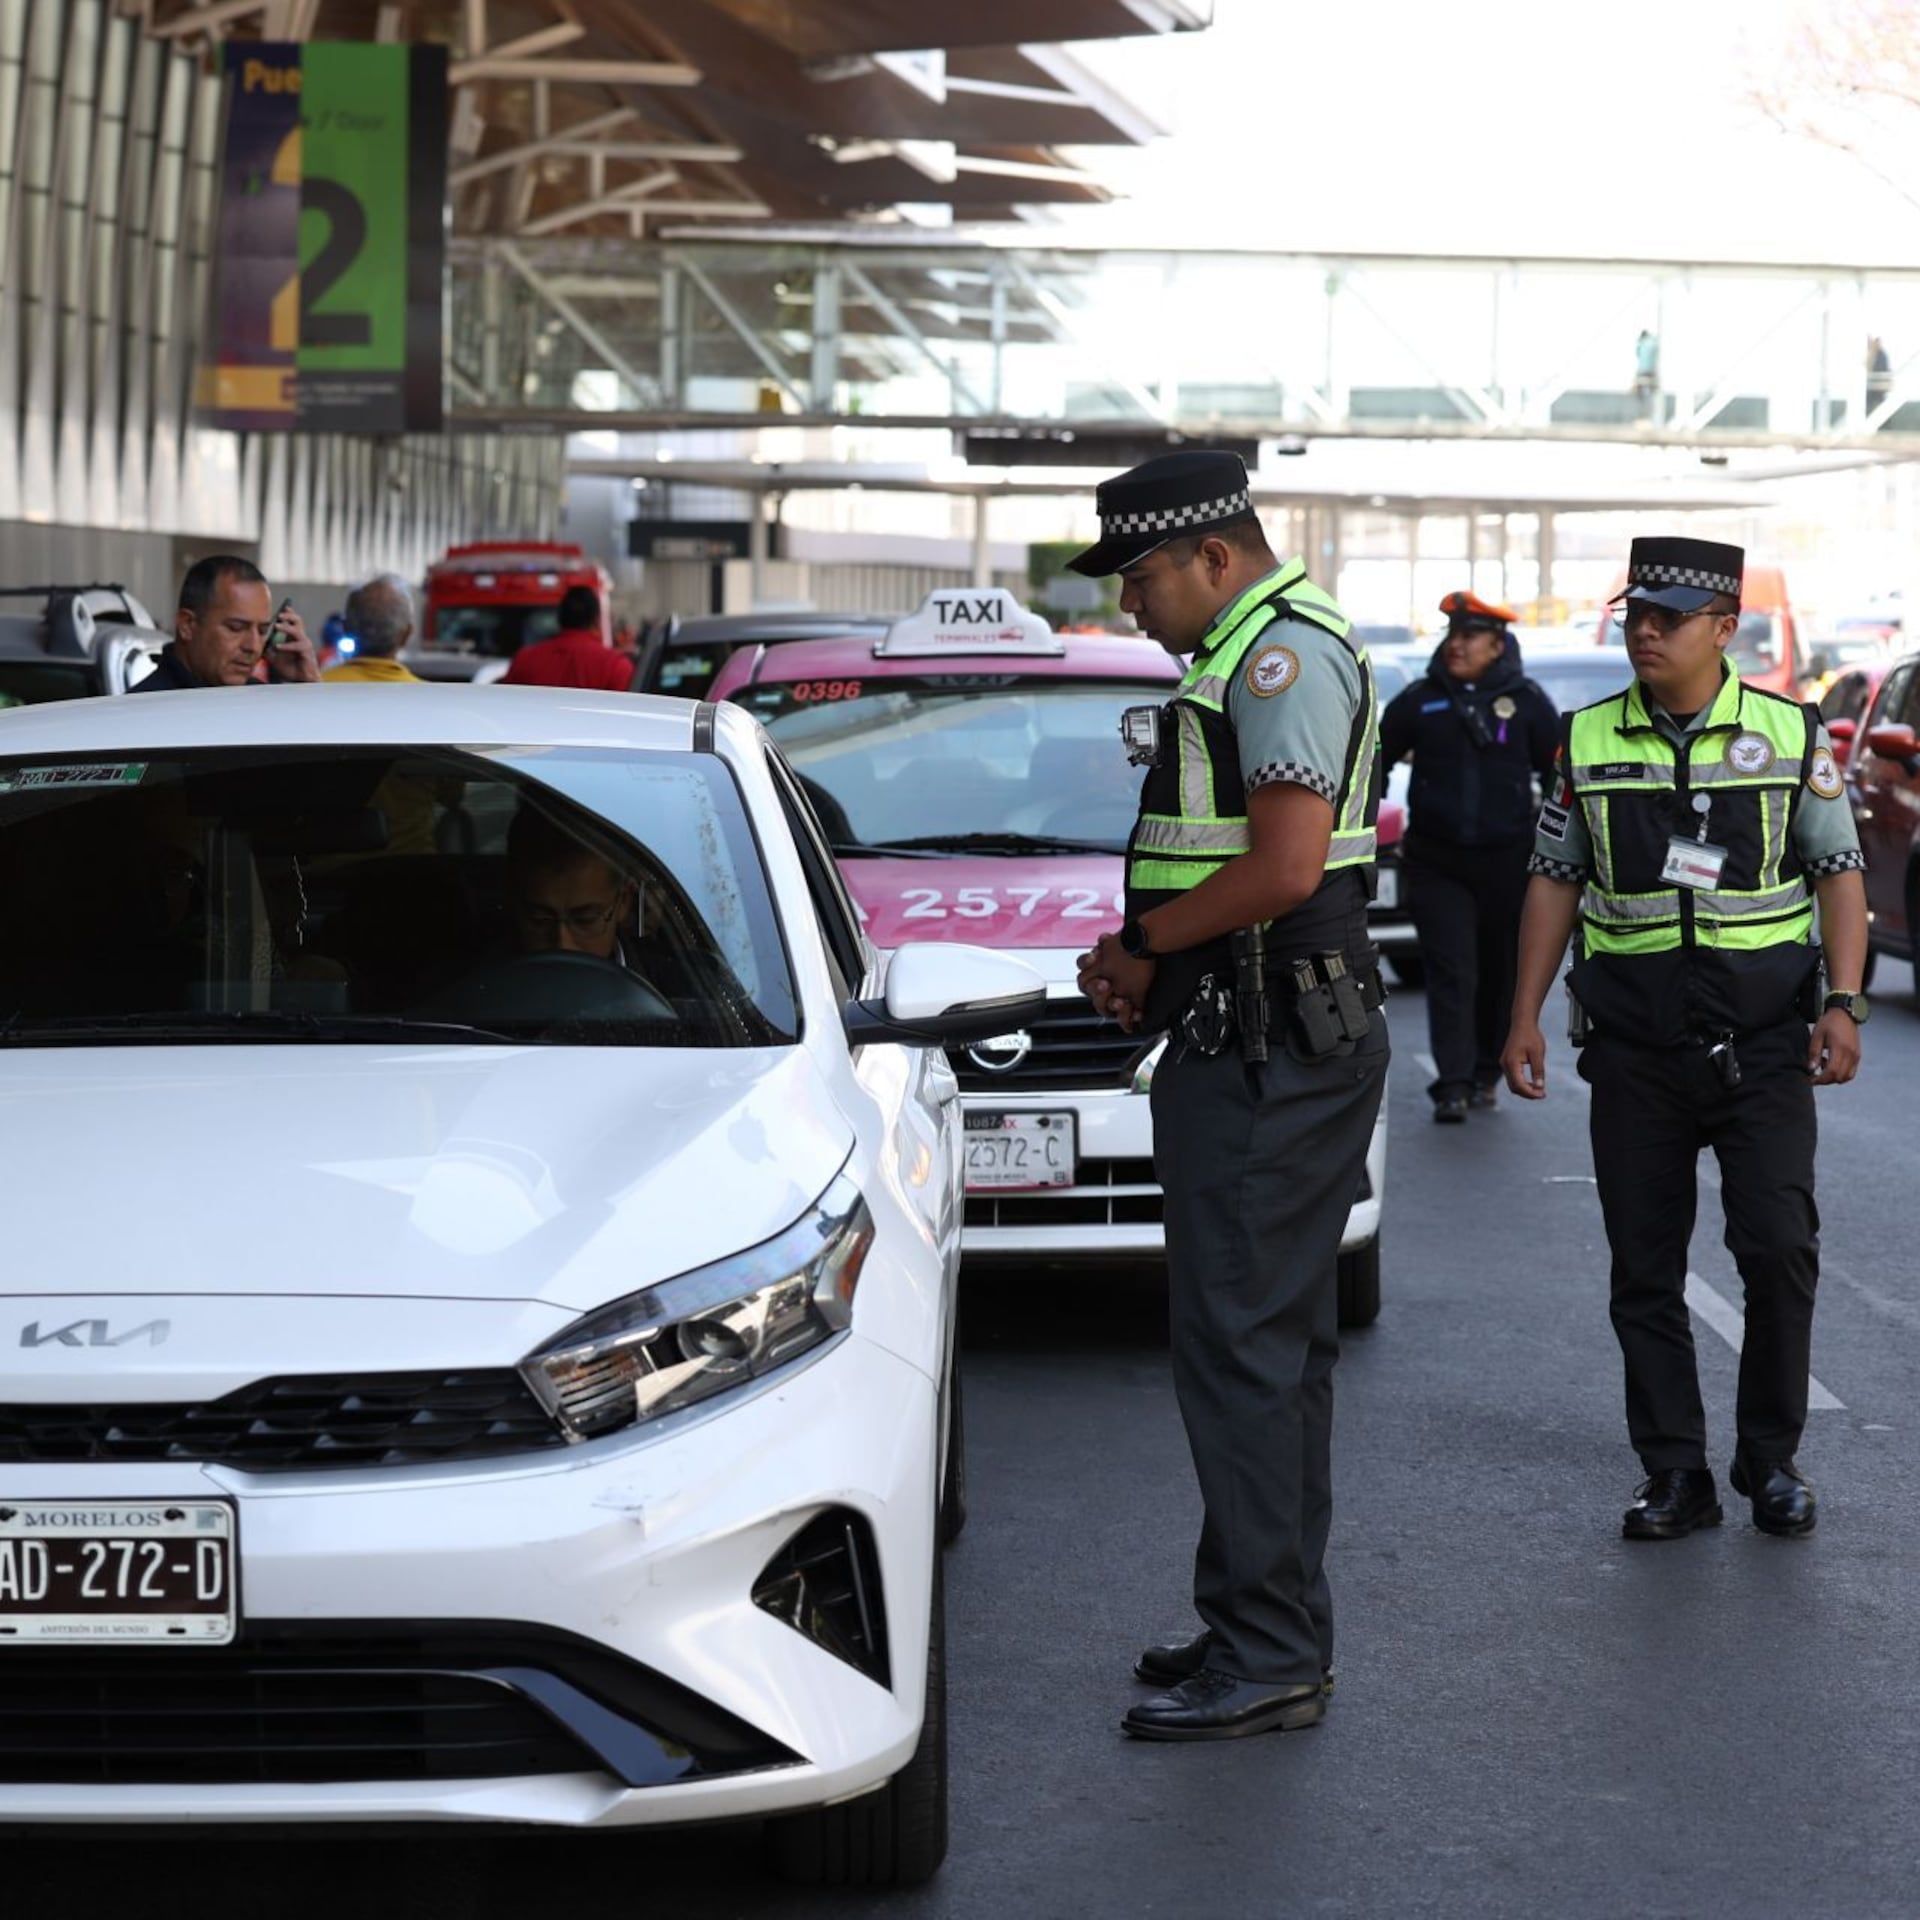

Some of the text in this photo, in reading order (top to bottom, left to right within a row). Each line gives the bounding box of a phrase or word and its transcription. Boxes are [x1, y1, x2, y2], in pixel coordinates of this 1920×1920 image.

[300, 176, 371, 347] 2
[933, 598, 1004, 624] TAXI
[793, 681, 862, 703] 0396
[901, 887, 1126, 918] 2572
[19, 1319, 171, 1348] KIA
[24, 1511, 162, 1527] MORELOS
[0, 1539, 223, 1601] AD-272-D
[94, 1624, 111, 1634] DEL
[113, 1624, 150, 1634] MUNDO
